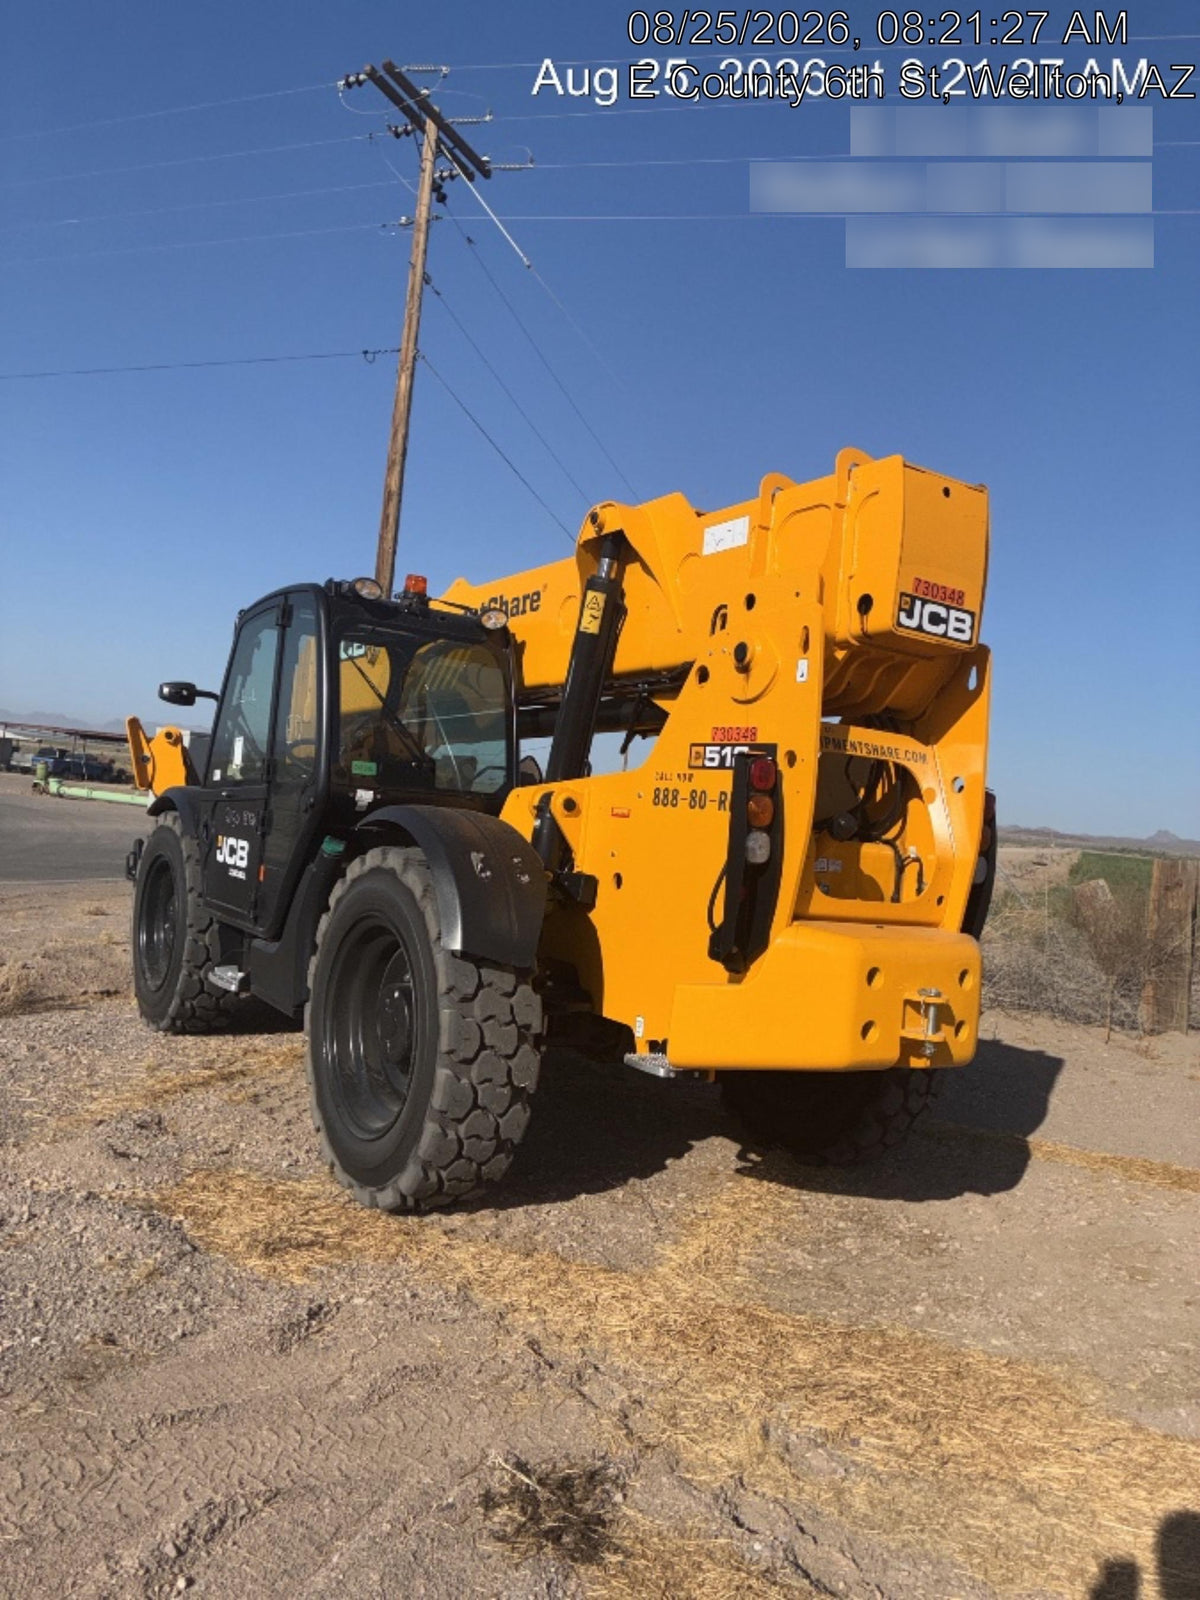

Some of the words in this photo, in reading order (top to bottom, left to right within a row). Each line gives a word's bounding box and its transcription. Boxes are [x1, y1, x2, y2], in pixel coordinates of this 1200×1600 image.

[912, 577, 966, 607] 730348
[898, 597, 972, 641] JCB
[711, 726, 758, 742] 730348
[652, 786, 732, 812] 888-80-R
[216, 834, 250, 869] JCB
